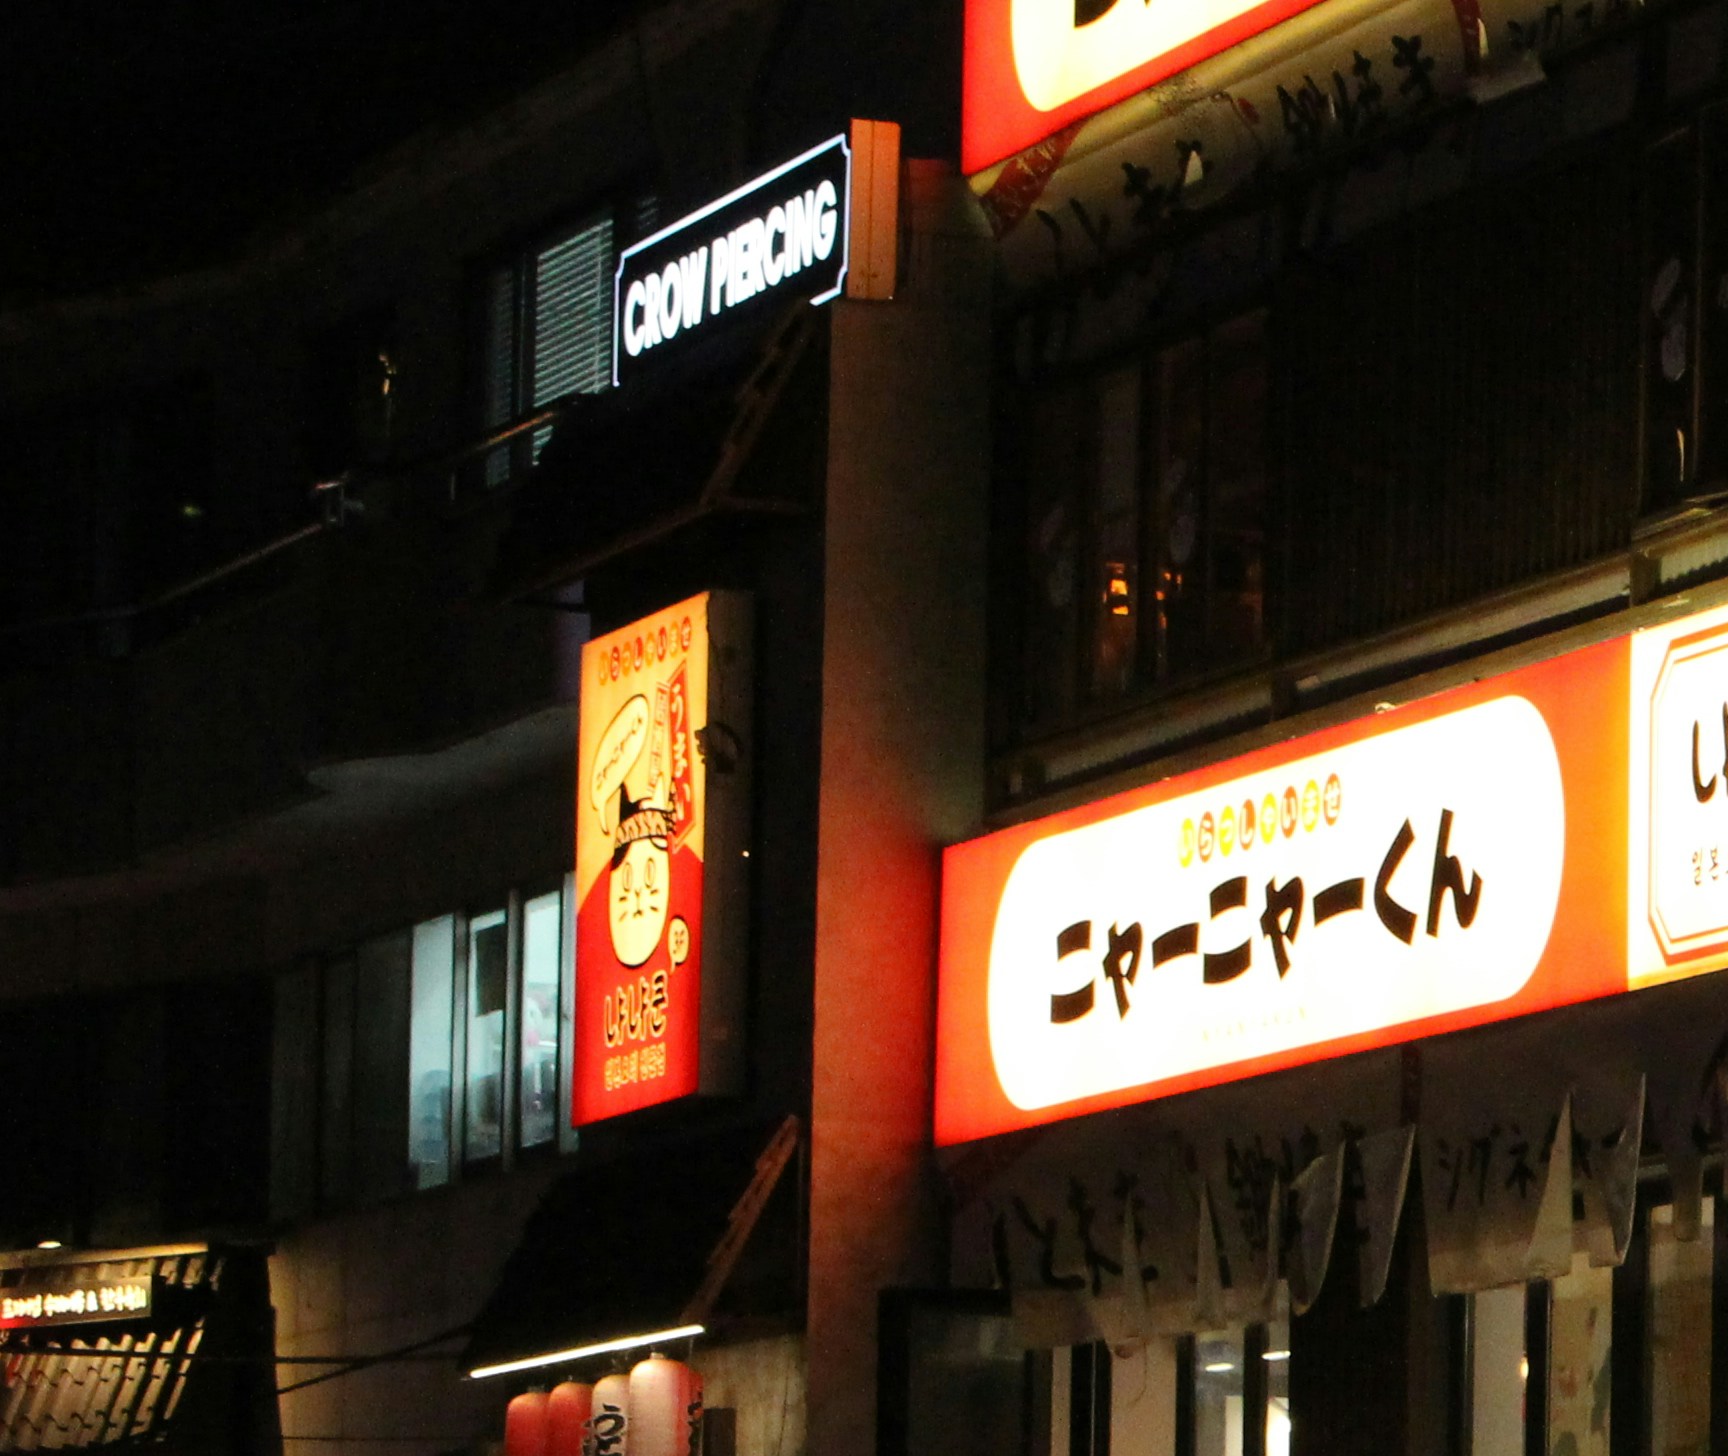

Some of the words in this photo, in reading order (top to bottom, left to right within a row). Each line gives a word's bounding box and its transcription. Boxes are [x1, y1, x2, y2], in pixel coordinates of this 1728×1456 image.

[623, 245, 708, 357] CROW
[710, 179, 837, 315] PIERCING
[1049, 807, 1483, 1024] ニャーニャーくん
[604, 970, 678, 1048] 냐냐쿤
